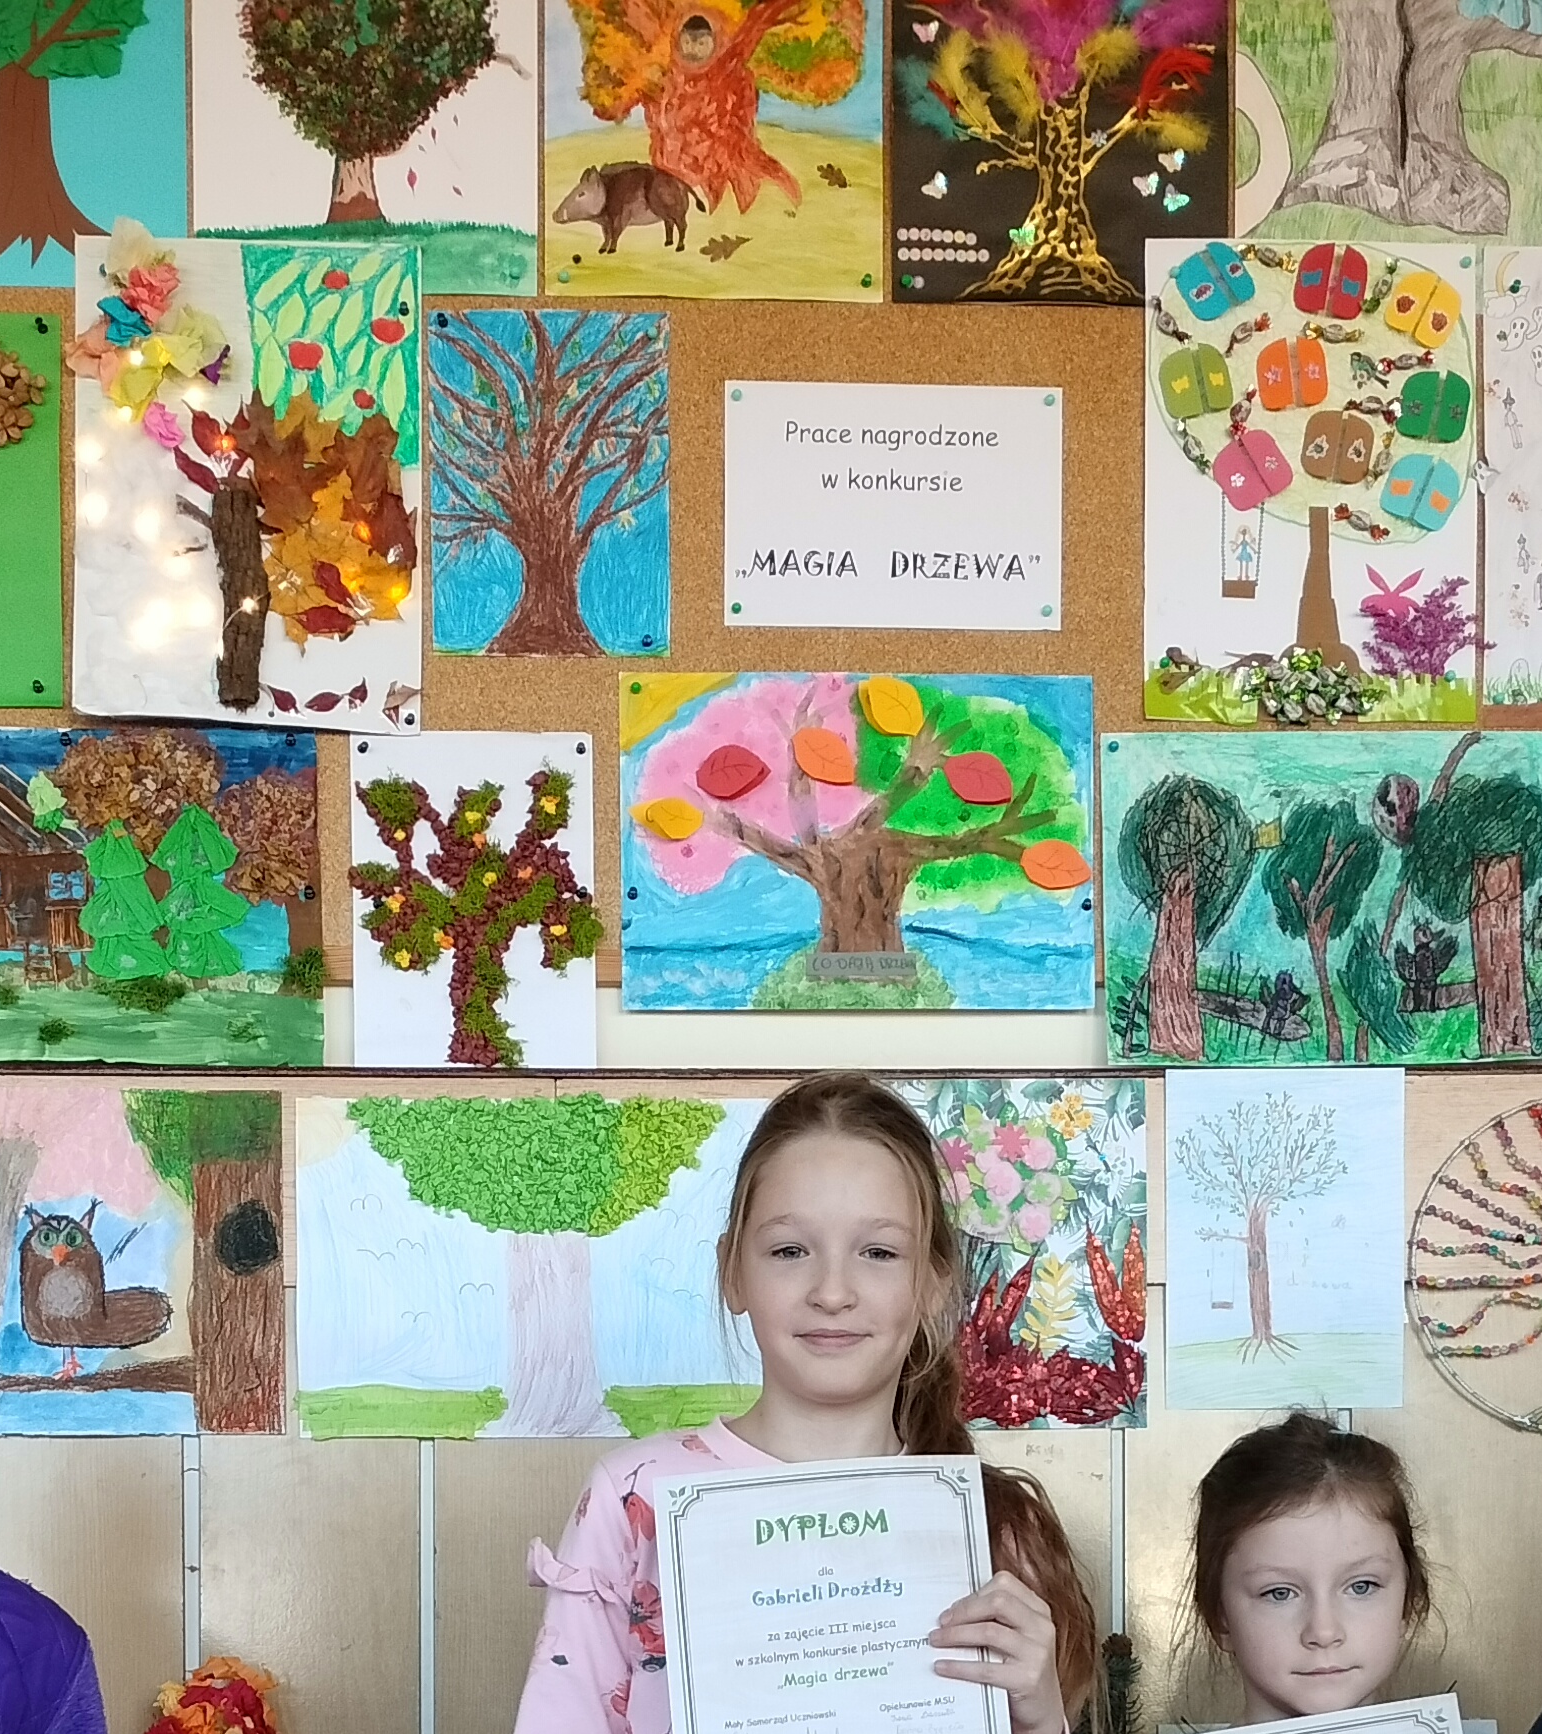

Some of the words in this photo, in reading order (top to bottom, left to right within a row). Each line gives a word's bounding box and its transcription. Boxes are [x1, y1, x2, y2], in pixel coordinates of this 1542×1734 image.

[785, 421, 852, 444] Prace
[861, 424, 1000, 451] nagrodzone
[821, 472, 838, 489] w
[848, 468, 963, 492] konkursie
[756, 1509, 889, 1545] DYPLOM
[818, 1566, 834, 1577] dla
[752, 1584, 823, 1607] Gabrieli
[829, 1577, 903, 1598] Drożdży
[768, 1632, 780, 1641] za
[785, 1626, 825, 1641] zajęcie
[829, 1623, 848, 1635] III
[853, 1619, 896, 1632] miejsca
[736, 1658, 744, 1667] w
[748, 1651, 799, 1665] szkolnym
[803, 1644, 858, 1659] konkursie
[880, 1698, 932, 1712] Opiekunowie
[934, 1696, 955, 1705] MSU
